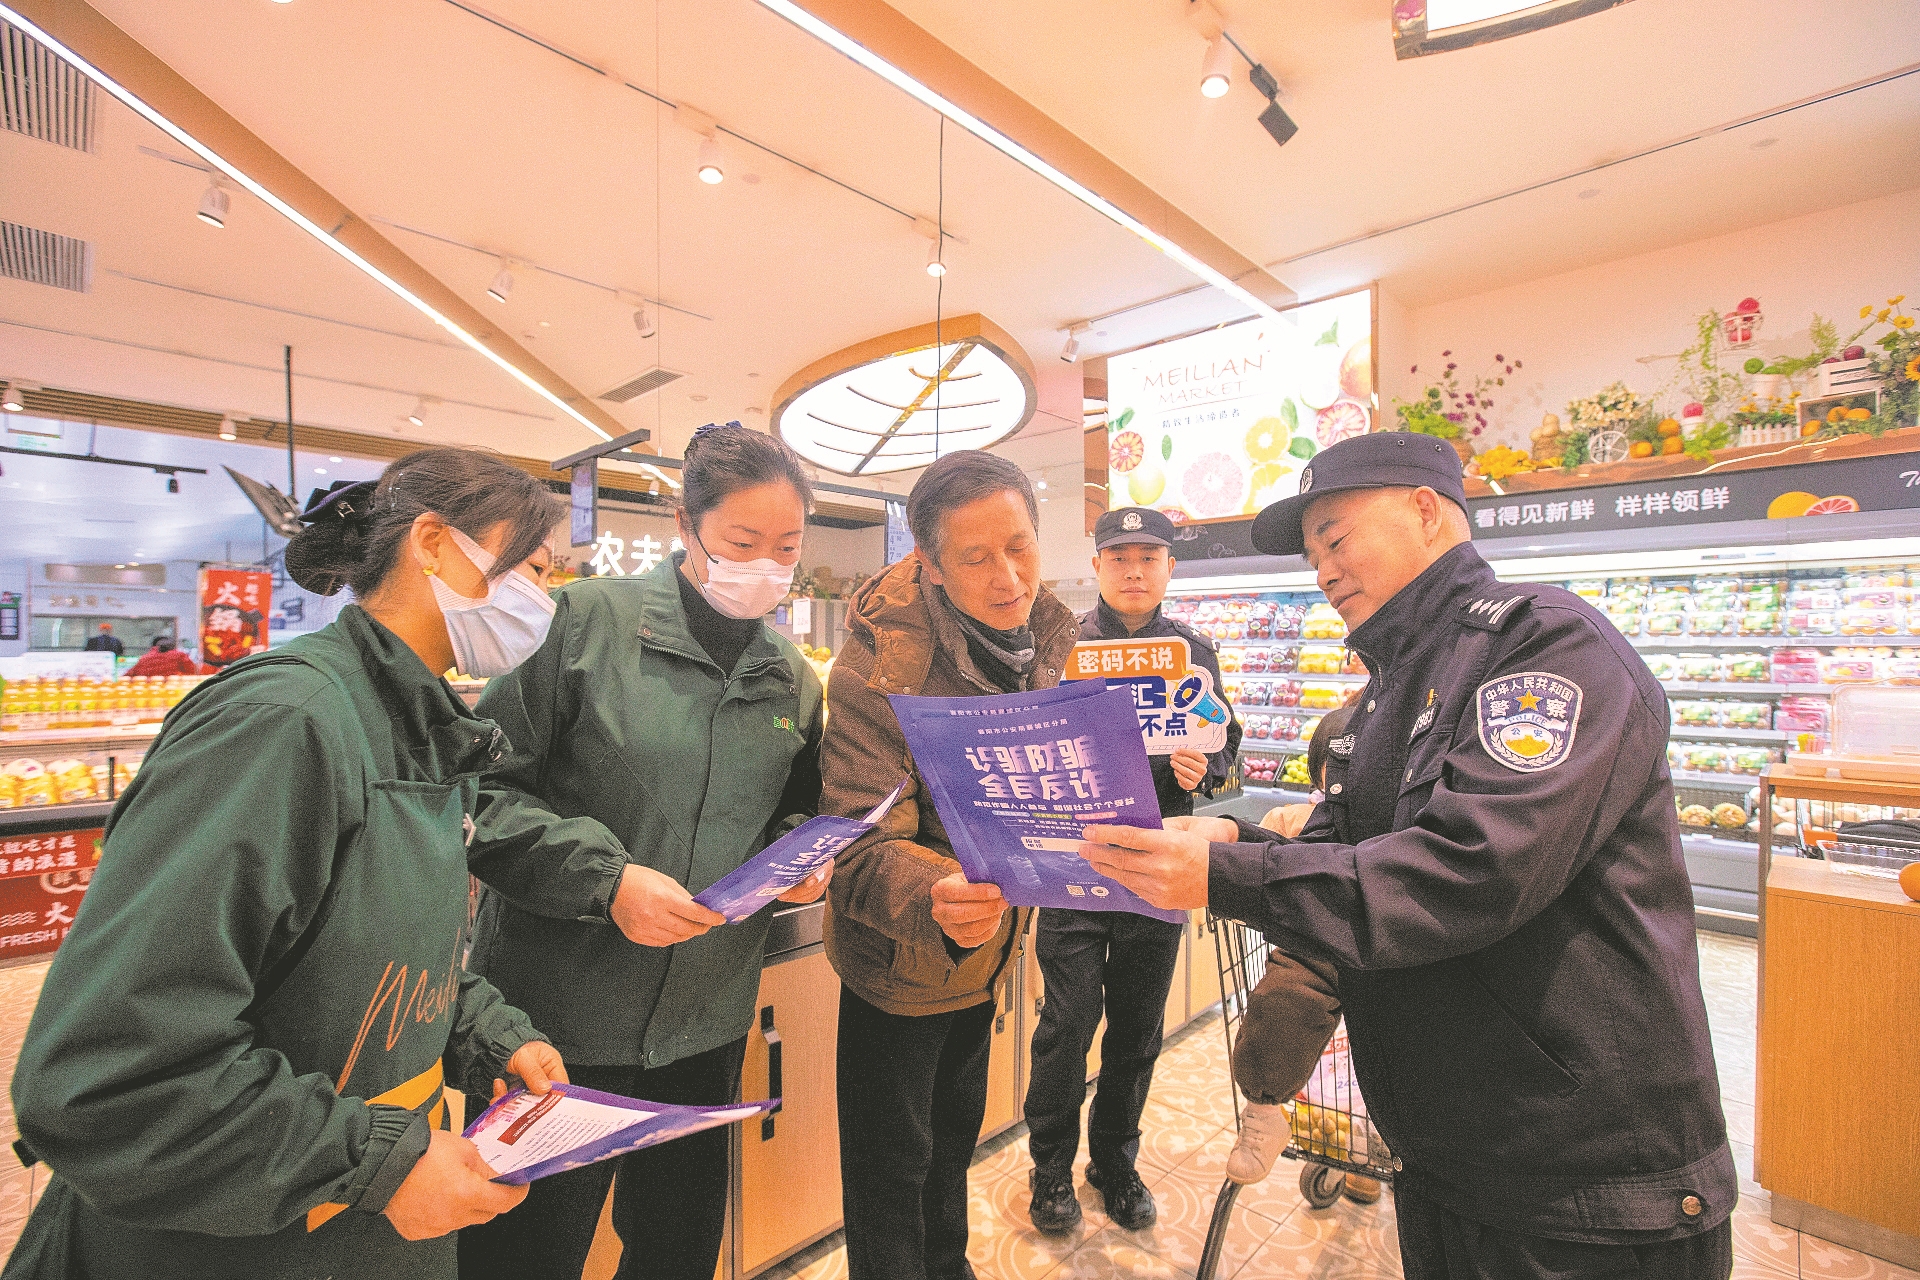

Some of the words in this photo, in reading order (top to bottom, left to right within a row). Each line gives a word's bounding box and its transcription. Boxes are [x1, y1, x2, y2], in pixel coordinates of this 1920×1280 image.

[1143, 354, 1263, 391] MEILIAN
[1159, 380, 1248, 405] MARKET
[1474, 499, 1595, 528] 看得见新鲜
[1615, 486, 1730, 518] 样样领鲜
[590, 530, 687, 576] 农夫
[1077, 646, 1174, 674] 密码不说
[1485, 676, 1575, 702] 中华人民共和国
[1508, 714, 1548, 725] POLICE
[965, 735, 1096, 773] 识骗防骗
[978, 769, 1104, 800] 全民反诈
[0, 928, 58, 948] FRESH
